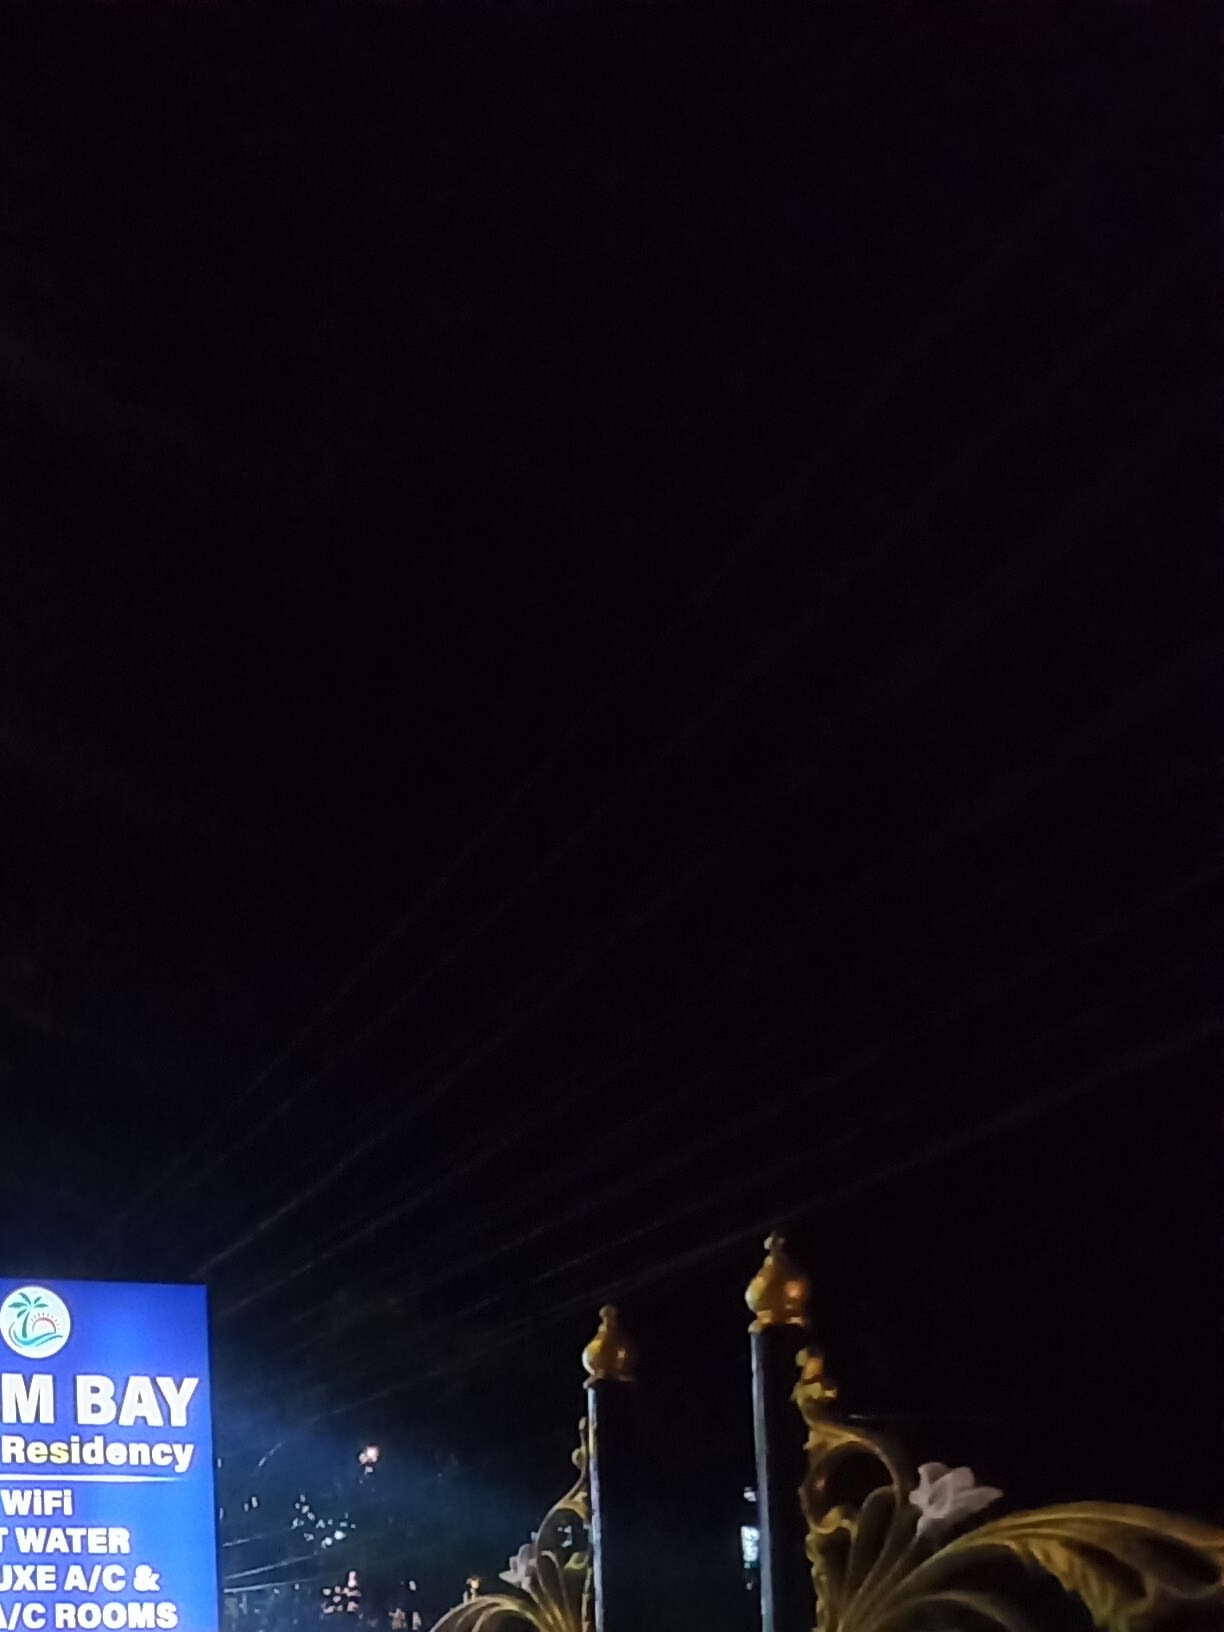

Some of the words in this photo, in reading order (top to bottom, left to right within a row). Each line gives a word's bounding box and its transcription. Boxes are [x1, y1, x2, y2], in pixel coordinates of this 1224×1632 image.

[76, 1374, 199, 1427] BAY
[1, 1435, 194, 1473] Residency
[0, 1489, 73, 1516] WiFi
[15, 1527, 130, 1554] WATER
[64, 1564, 126, 1592] A/C
[133, 1565, 160, 1591] &
[55, 1602, 178, 1630] ROOMS
